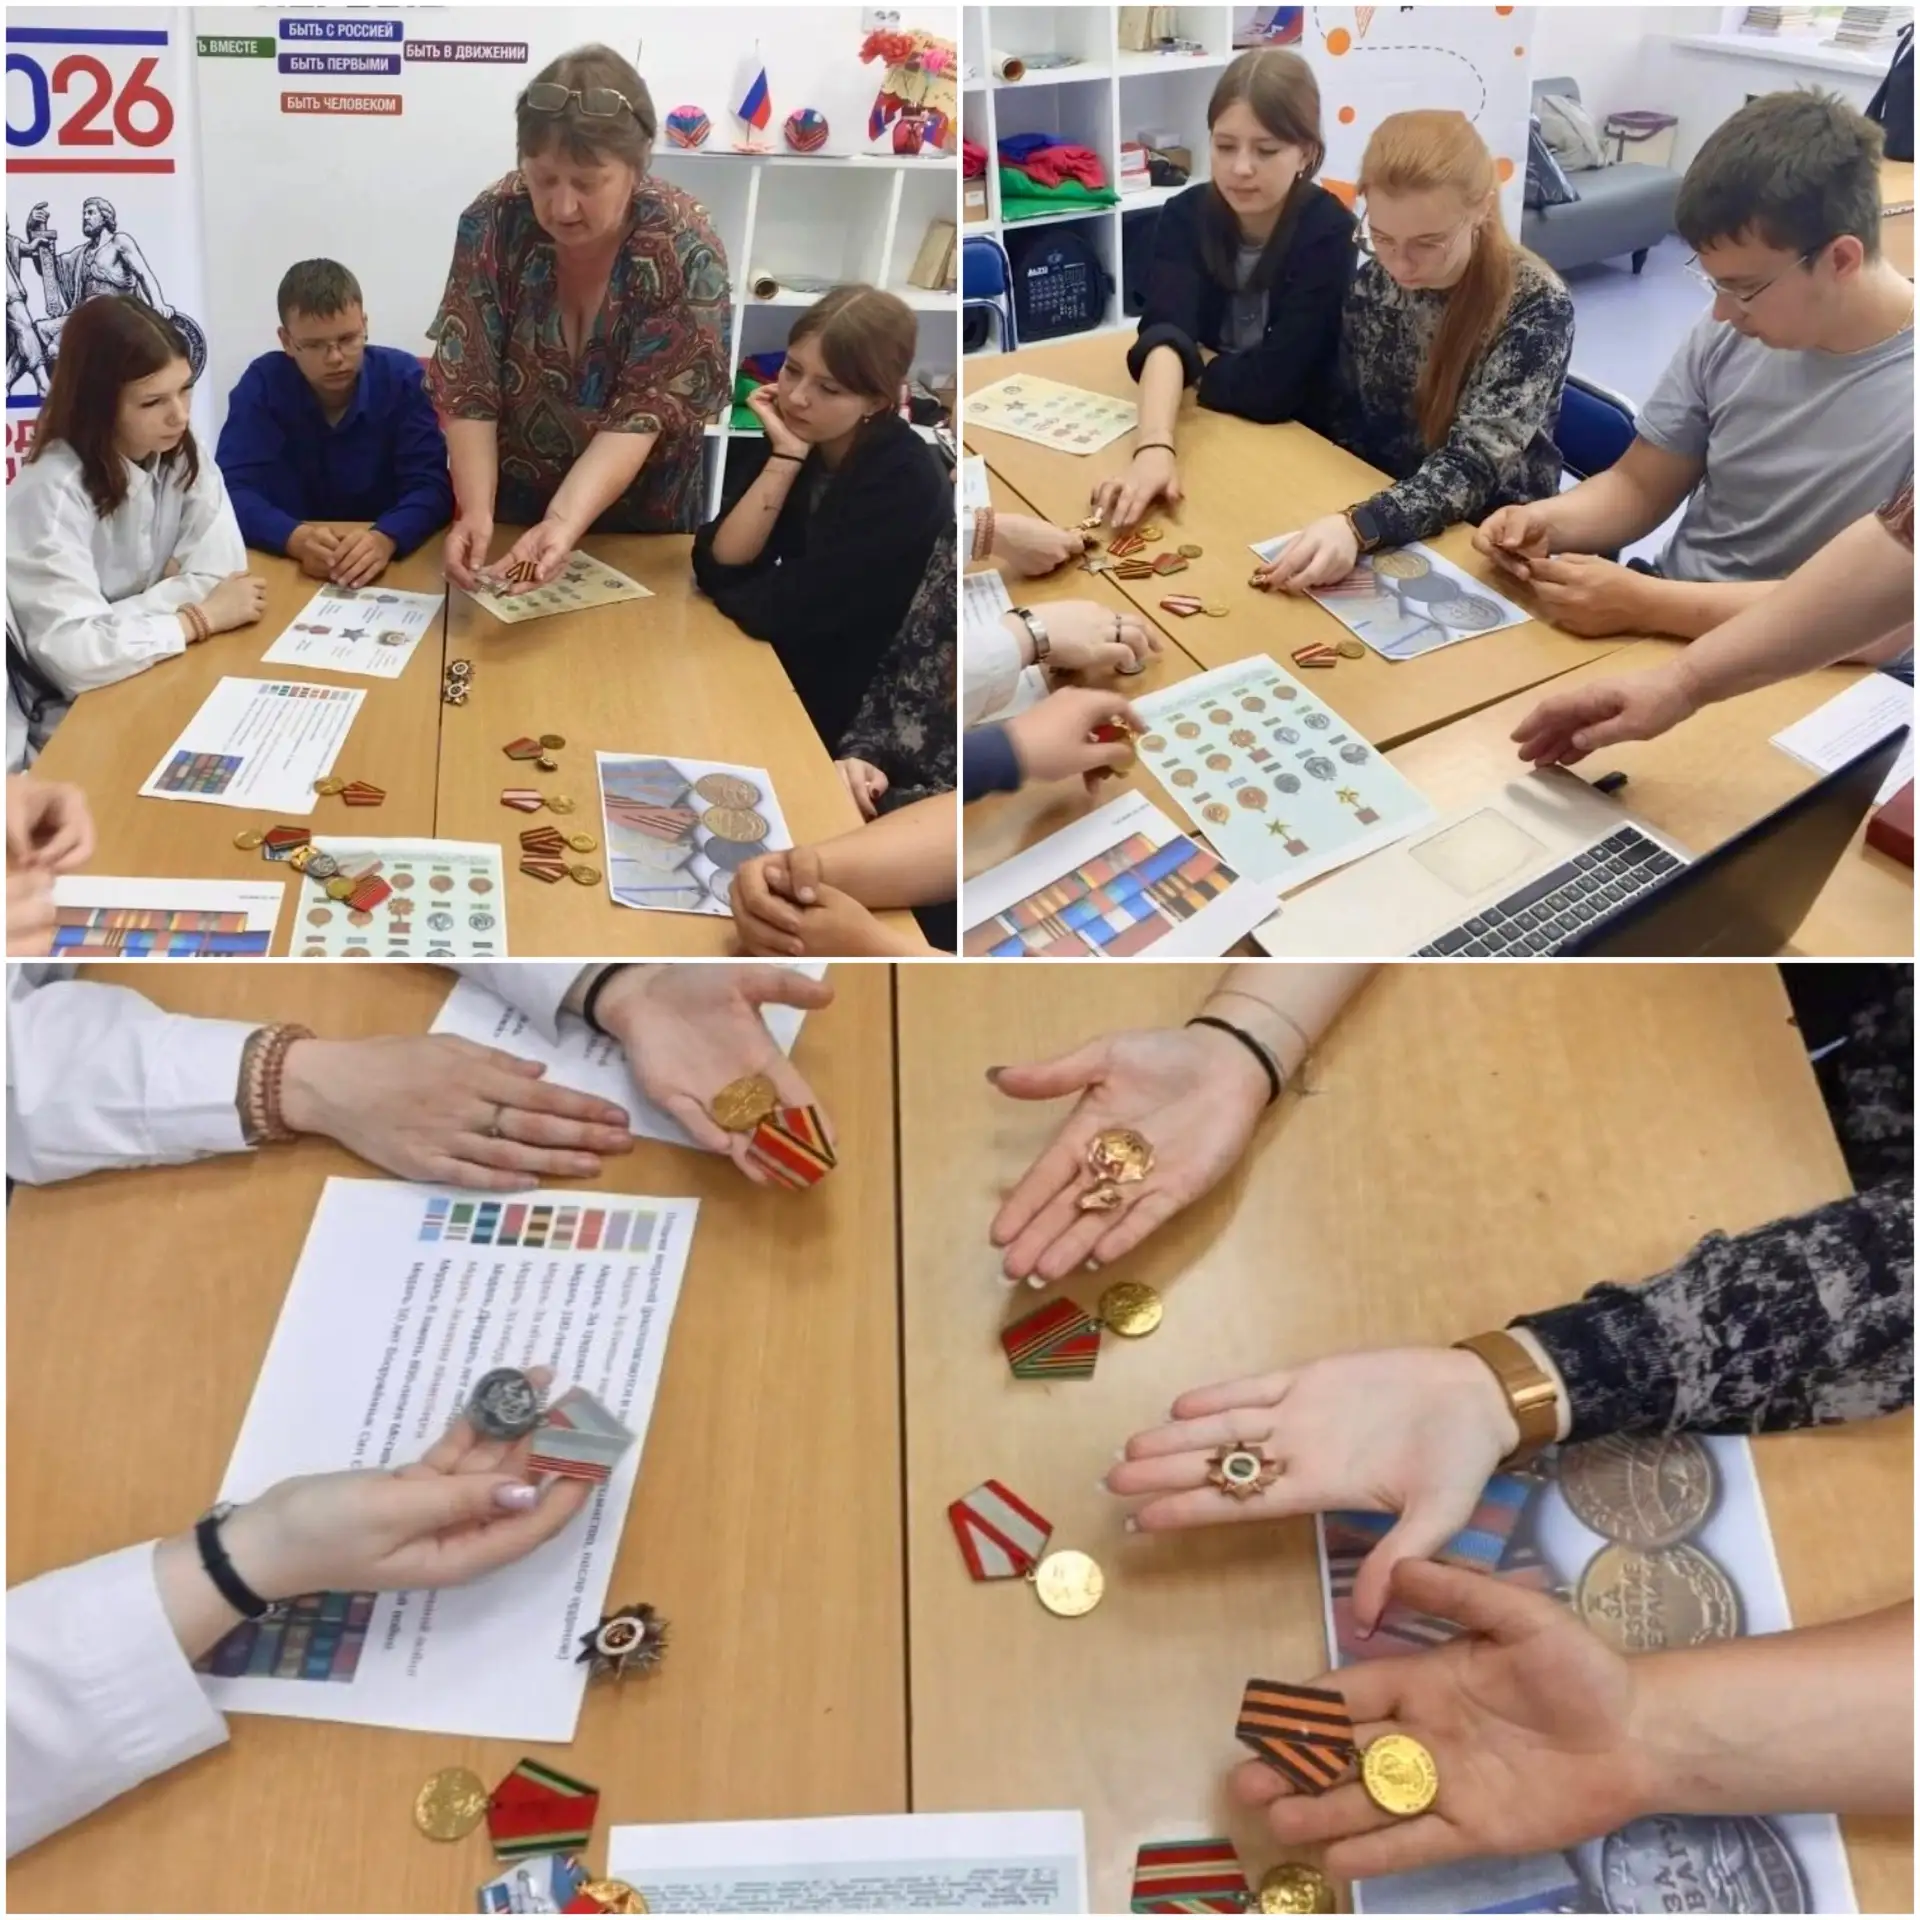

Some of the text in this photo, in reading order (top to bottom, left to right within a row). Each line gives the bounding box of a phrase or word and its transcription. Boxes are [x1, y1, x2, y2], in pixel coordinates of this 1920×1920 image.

[289, 22, 393, 38] БЫТЬ С РОССИЕЙ
[210, 40, 258, 54] ВМЕСТЕ
[406, 44, 526, 60] БЫТЬ В ДВИЖЕНИИ
[290, 57, 389, 71] БЫТЬ ПЕРВЫМИ
[287, 96, 396, 111] БЫТЬ ЧЕЛОВЕКОМ
